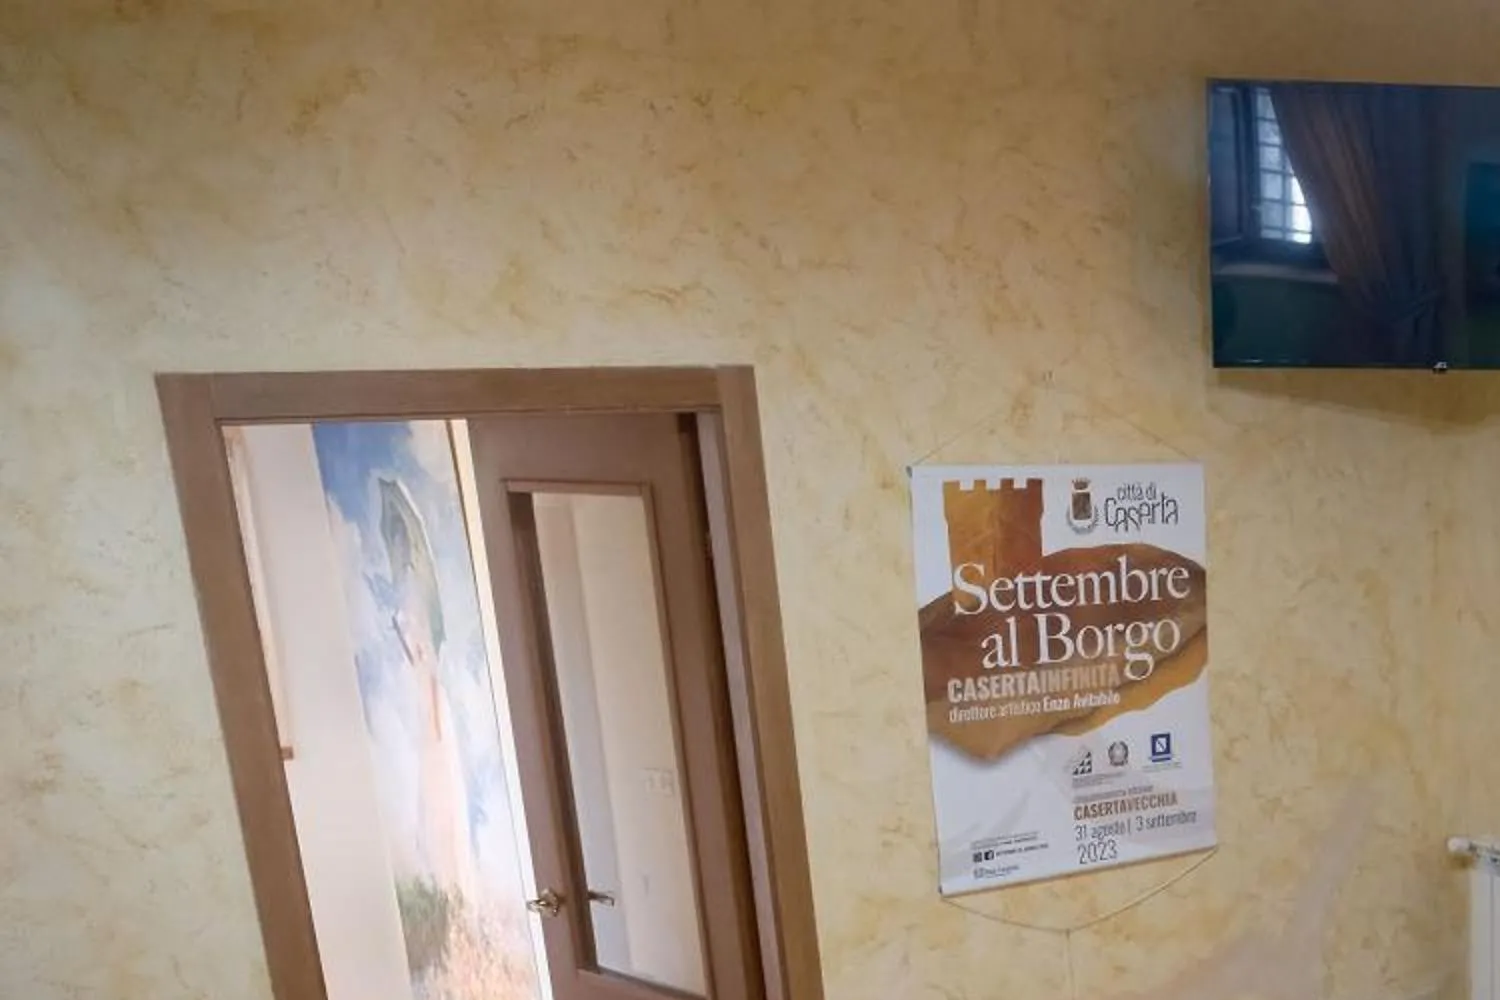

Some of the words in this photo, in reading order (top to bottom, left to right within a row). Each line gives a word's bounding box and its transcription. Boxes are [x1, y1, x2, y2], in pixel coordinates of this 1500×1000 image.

[1104, 491, 1179, 533] Caserta
[954, 554, 1190, 615] Settembre
[980, 616, 1020, 669] al
[1033, 612, 1181, 680] Borgo
[1043, 697, 1071, 712] Enzo
[1073, 792, 1178, 821] CASERTAVECCHIA
[1075, 824, 1087, 841] 31
[1136, 815, 1143, 831] 3
[1077, 840, 1118, 865] 2023
